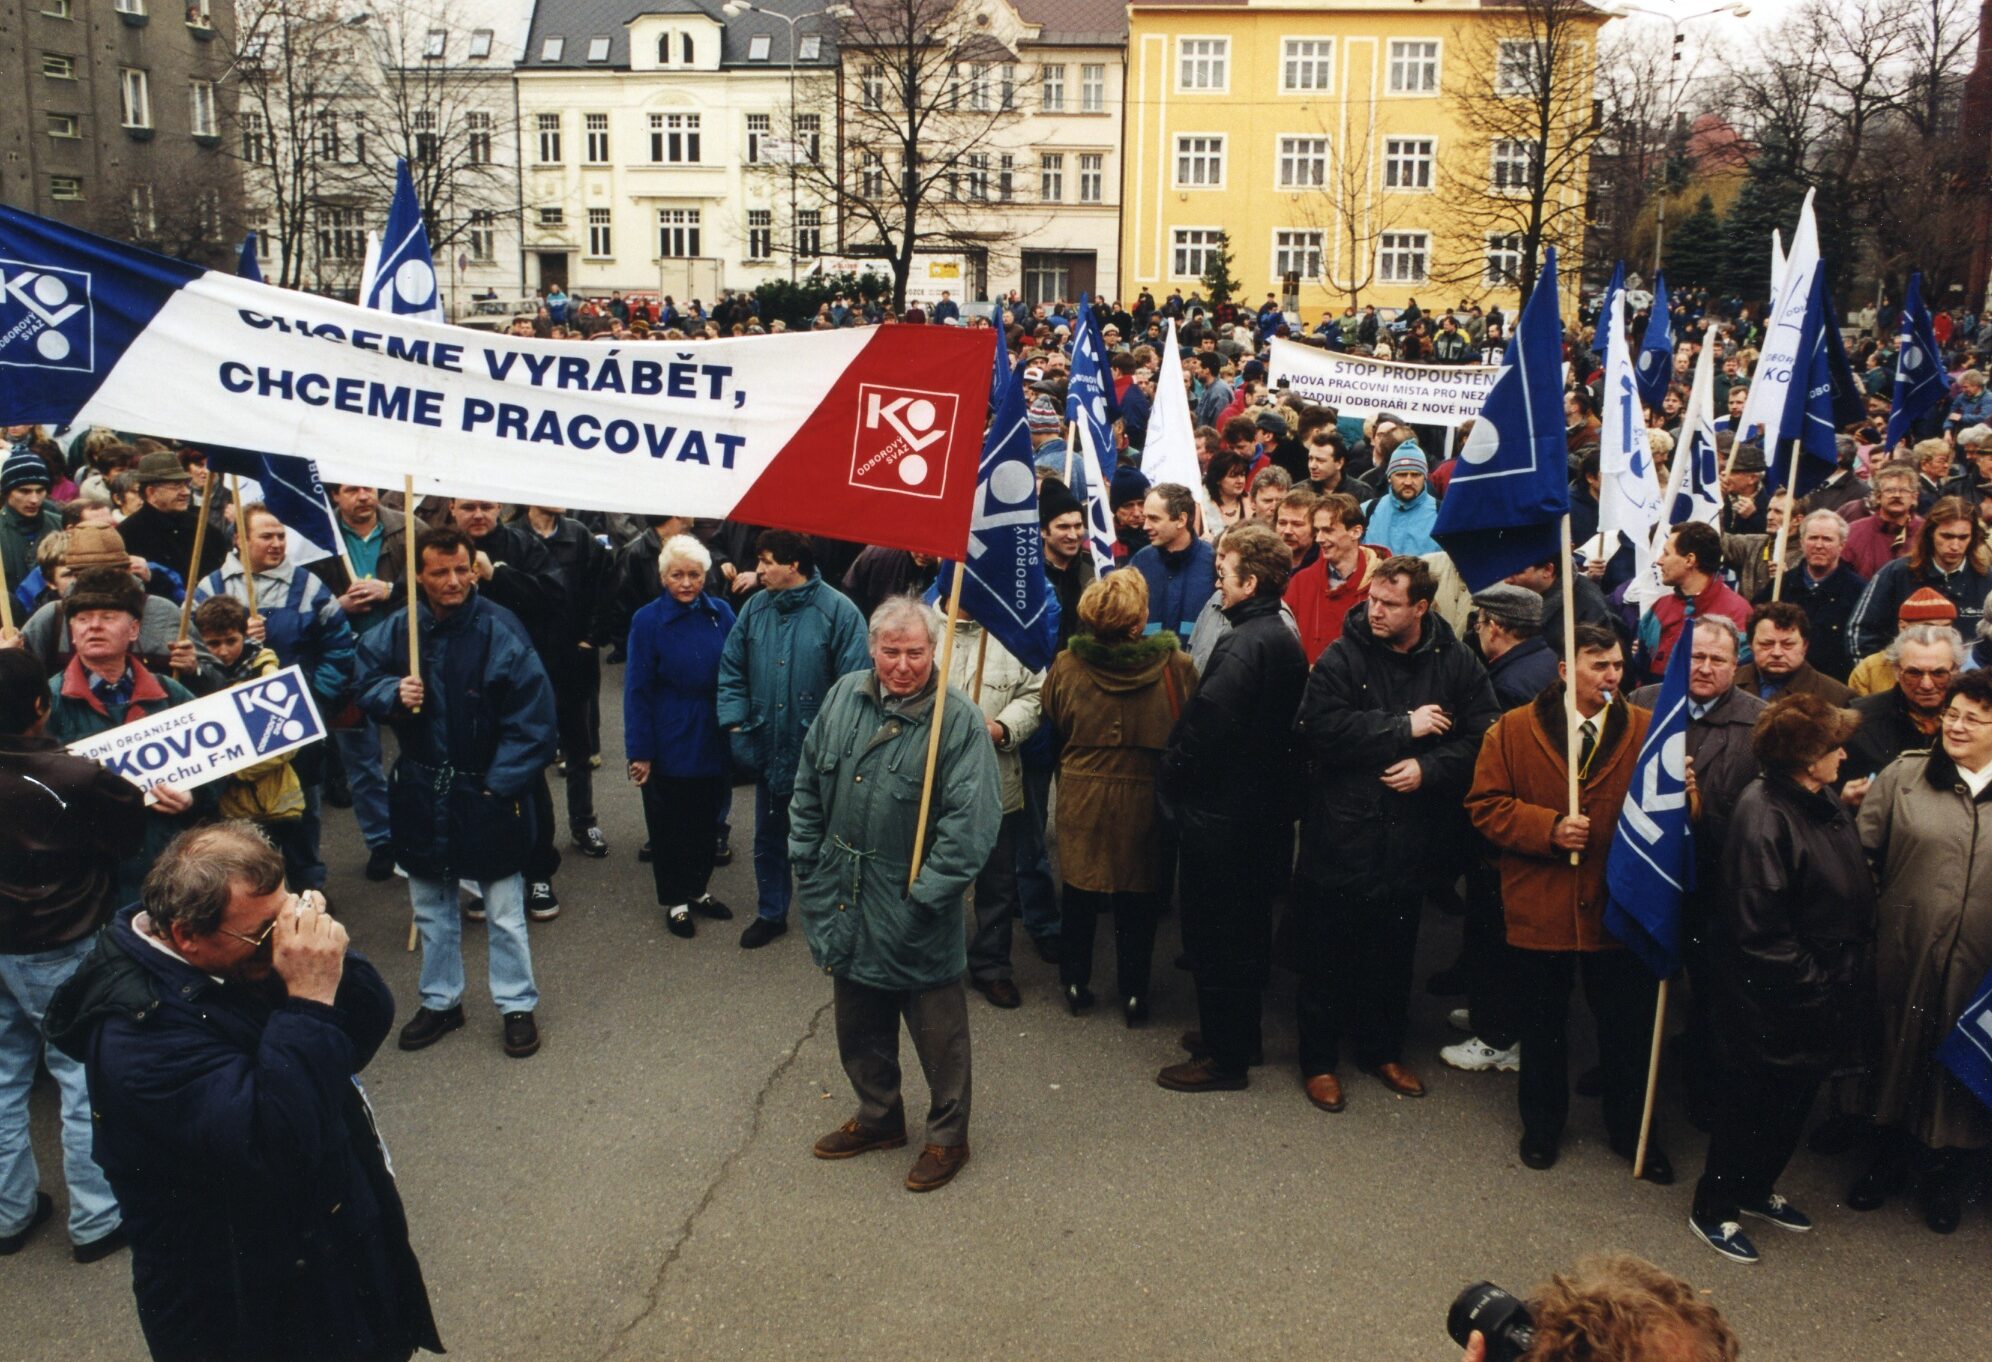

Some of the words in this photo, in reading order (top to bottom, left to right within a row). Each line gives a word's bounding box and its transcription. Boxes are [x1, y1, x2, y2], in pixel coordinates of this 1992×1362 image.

[0, 310, 37, 352] DBOROVÝ
[20, 319, 45, 341] SVAZ
[483, 349, 746, 409] VYRÁBĚT,
[1335, 361, 1377, 376] STOP
[1411, 402, 1419, 411] Z
[1433, 388, 1457, 398] PRO
[219, 361, 445, 428] CHCEME
[462, 397, 746, 469] PRACOVAT
[857, 435, 904, 476] ODBOROVÝ
[866, 393, 947, 485] KOVO
[886, 444, 910, 465] SVAZ
[1028, 527, 1039, 565] SVAZ
[1015, 526, 1027, 610] ODBOROVÝ
[116, 712, 197, 749] ORGANIZACE
[239, 681, 304, 741] KOVO
[105, 721, 227, 776] KOVO
[208, 743, 245, 768] F-M
